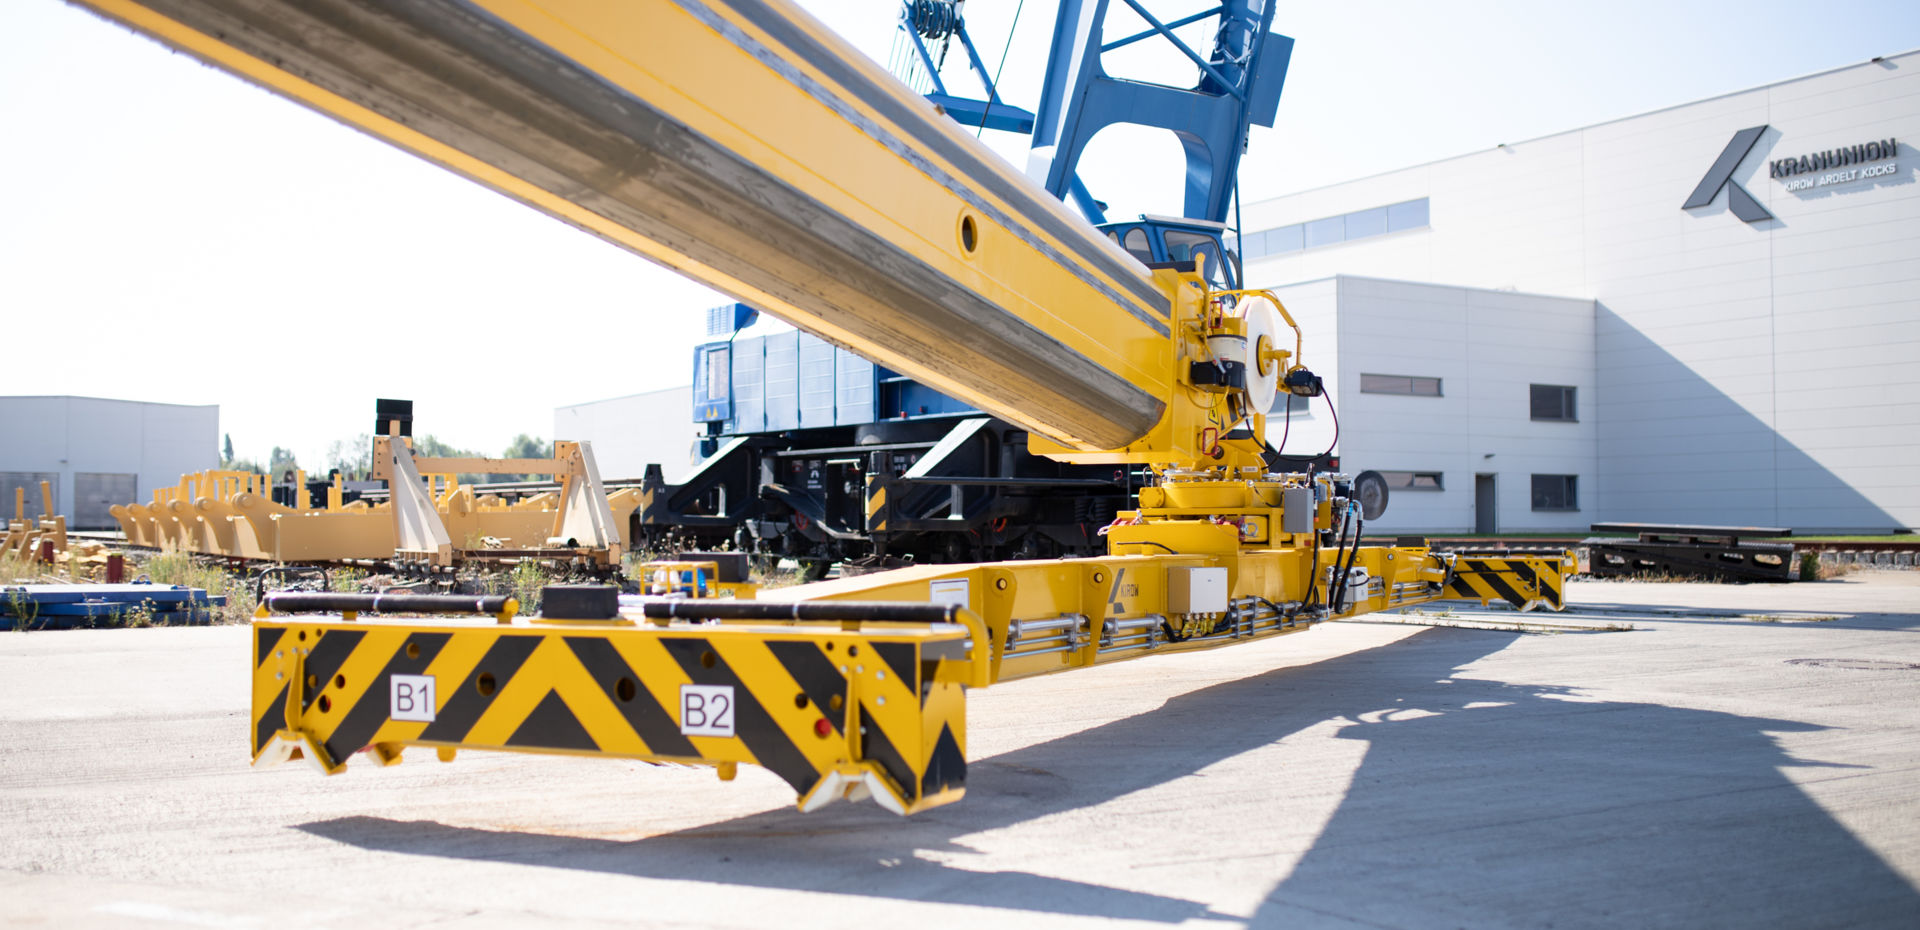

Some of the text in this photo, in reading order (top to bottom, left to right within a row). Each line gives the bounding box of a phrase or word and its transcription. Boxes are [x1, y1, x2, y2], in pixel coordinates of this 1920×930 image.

[1769, 137, 1896, 178] KRANUNION
[1784, 162, 1896, 192] KIROW ARDELT KOCKS
[1121, 583, 1139, 598] KIROW
[397, 683, 428, 713] B1
[685, 693, 730, 728] B2
